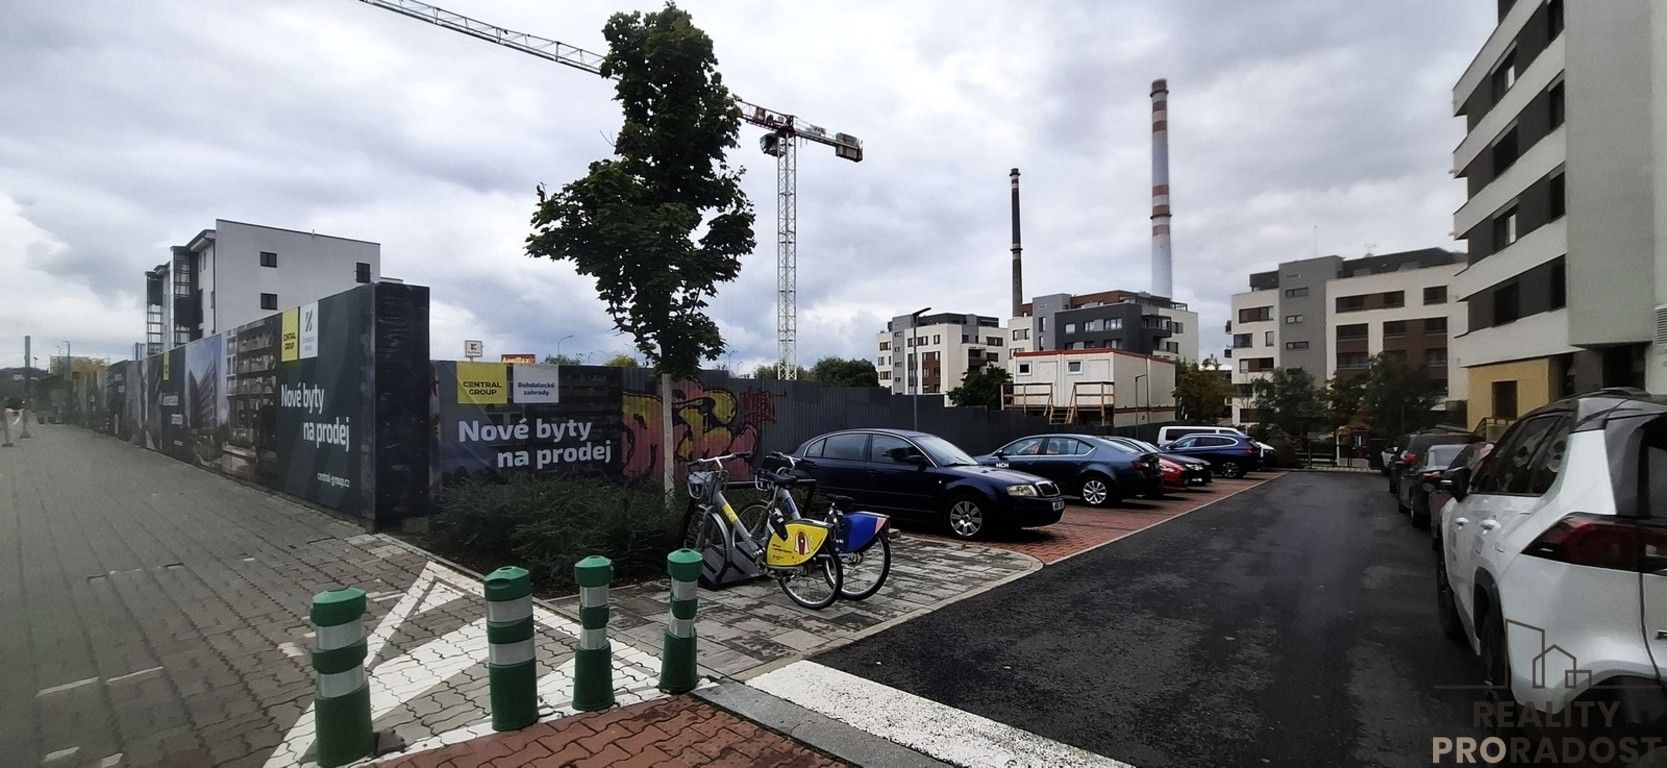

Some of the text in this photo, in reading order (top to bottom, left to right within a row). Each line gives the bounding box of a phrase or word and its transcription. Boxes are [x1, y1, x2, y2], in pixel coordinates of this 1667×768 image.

[281, 382, 324, 414] Nové byty
[523, 389, 550, 397] zahrady
[303, 416, 349, 452] na prodej
[458, 417, 592, 443] Nové byty
[498, 440, 612, 469] na prodej
